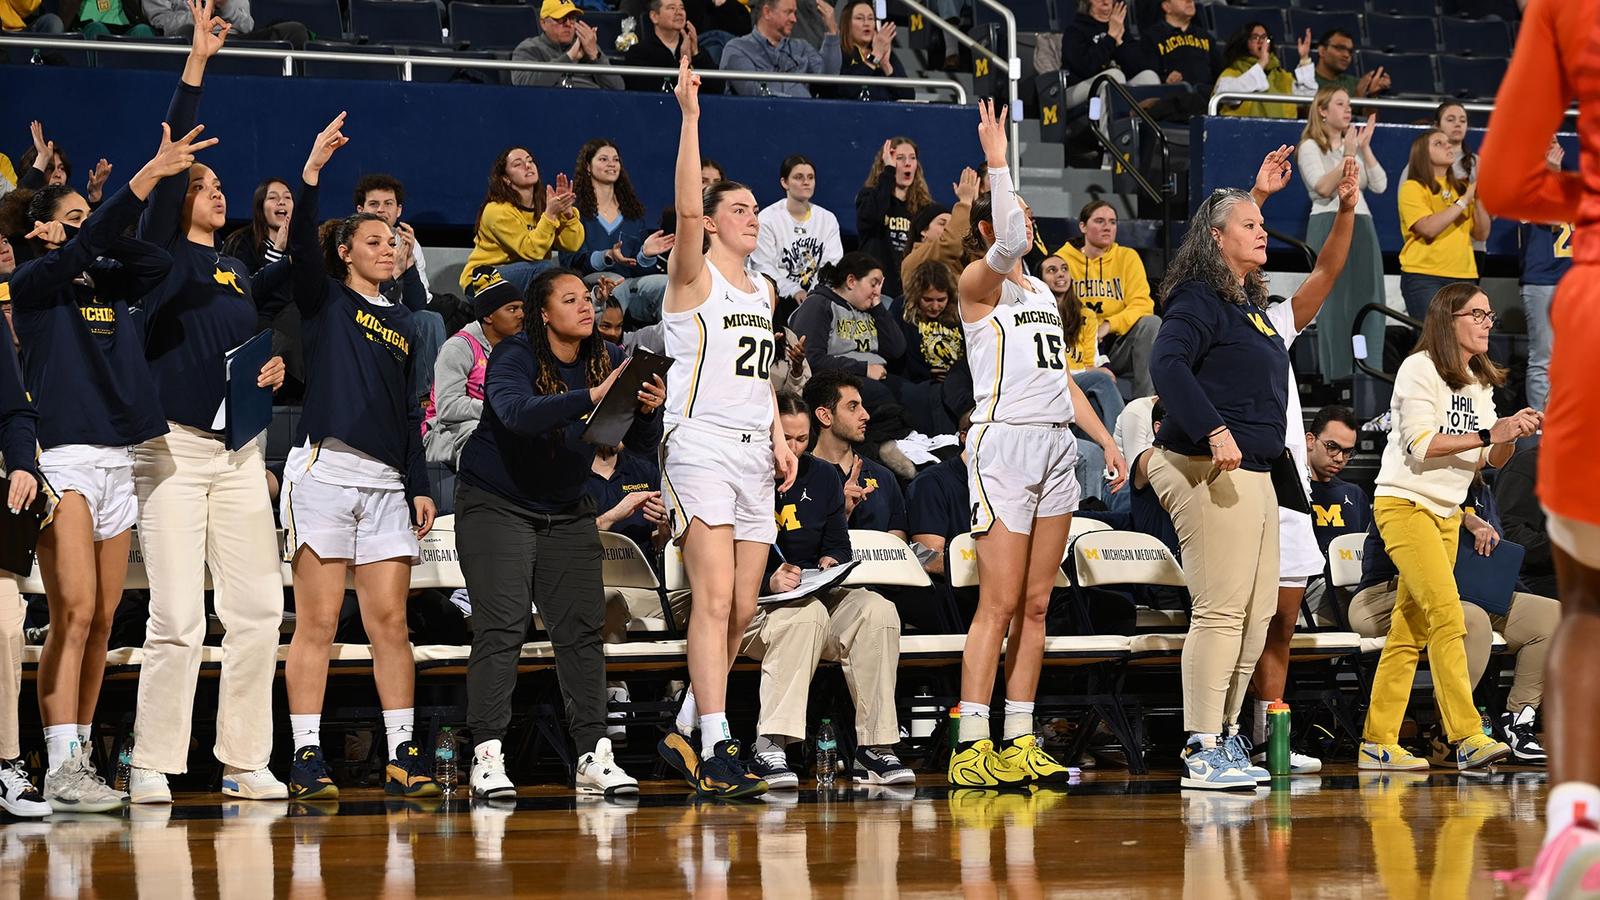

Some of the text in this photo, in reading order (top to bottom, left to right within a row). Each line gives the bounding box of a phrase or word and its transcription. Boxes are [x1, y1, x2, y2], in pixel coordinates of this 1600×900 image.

[975, 58, 989, 78] M
[1043, 104, 1058, 126] M
[855, 338, 871, 353] M
[1033, 332, 1064, 370] 15
[735, 335, 774, 380] 20
[1451, 394, 1474, 413] HAIL
[1446, 410, 1460, 427] TO
[1463, 413, 1479, 431] THE
[741, 434, 751, 443] M
[1312, 503, 1346, 527] M
[872, 548, 908, 561] MEDICINE
[1084, 548, 1168, 561] M MICHIGAN MEDICINE
[1338, 549, 1354, 560] M
